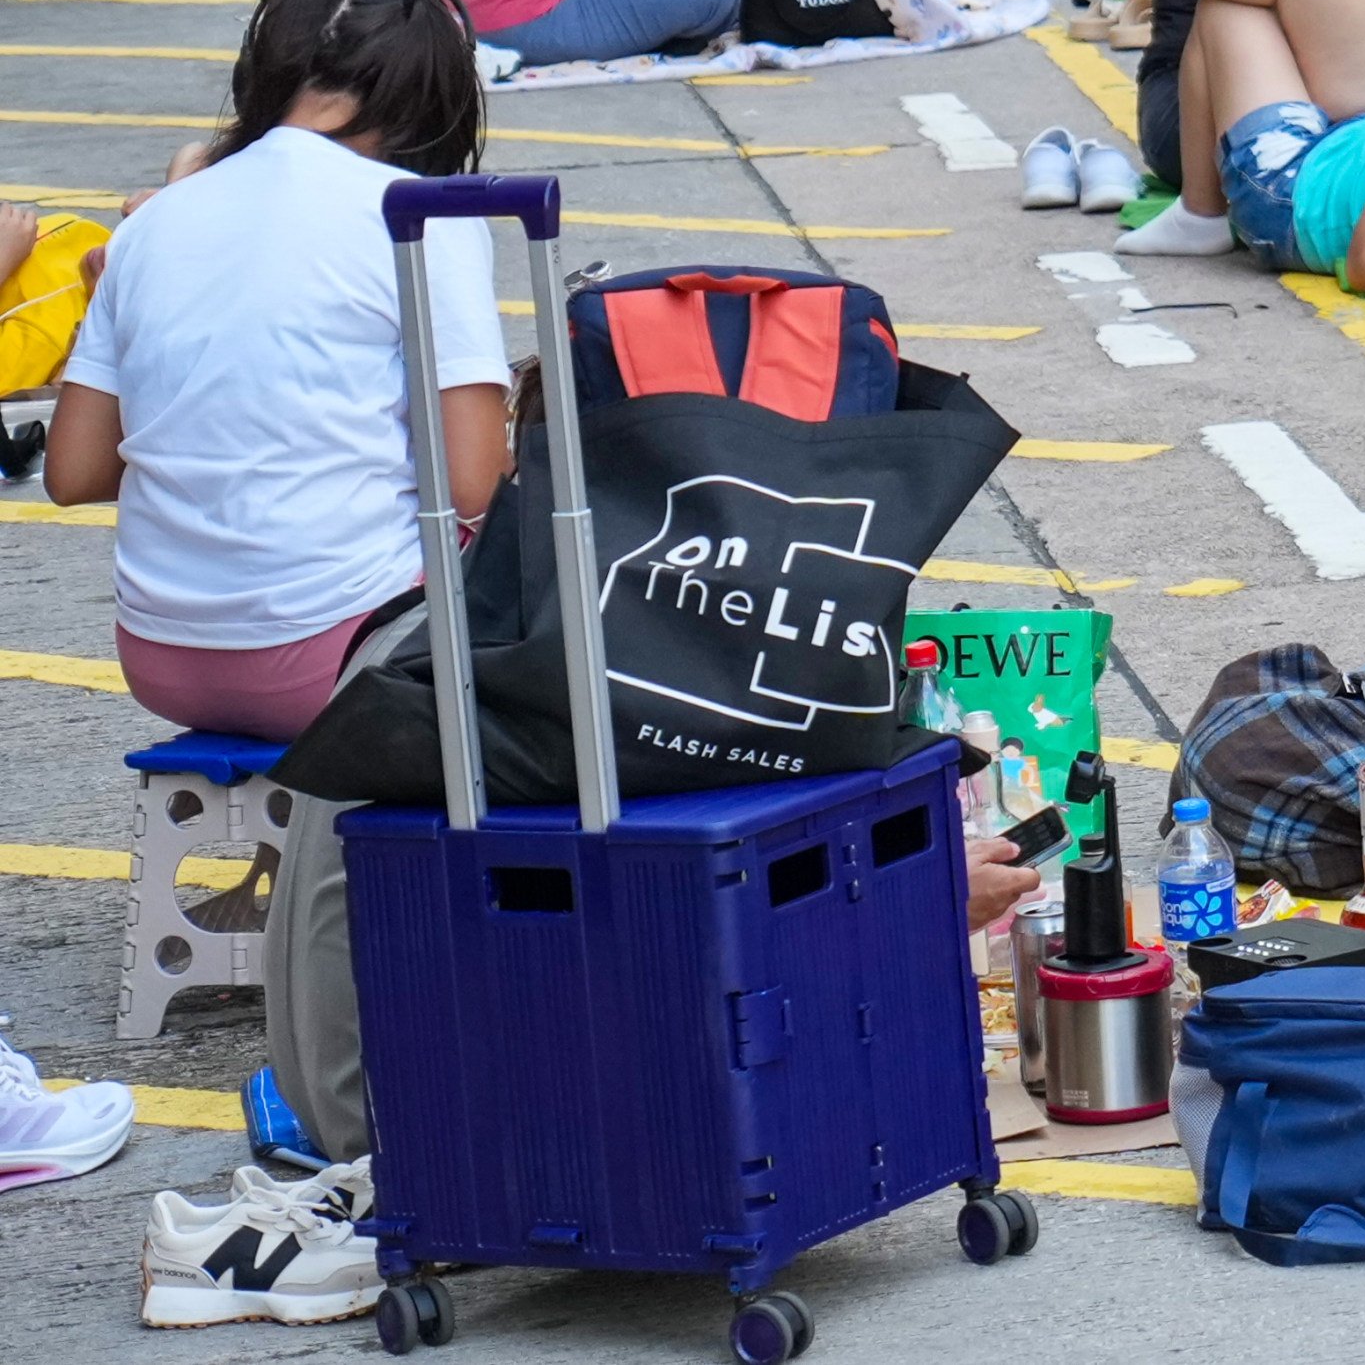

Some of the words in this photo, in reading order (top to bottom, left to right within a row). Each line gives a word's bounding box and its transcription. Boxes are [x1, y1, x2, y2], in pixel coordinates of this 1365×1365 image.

[665, 535, 748, 569] on
[637, 724, 718, 759] FLASH
[726, 747, 804, 773] SALES
[164, 1268, 198, 1280] balance
